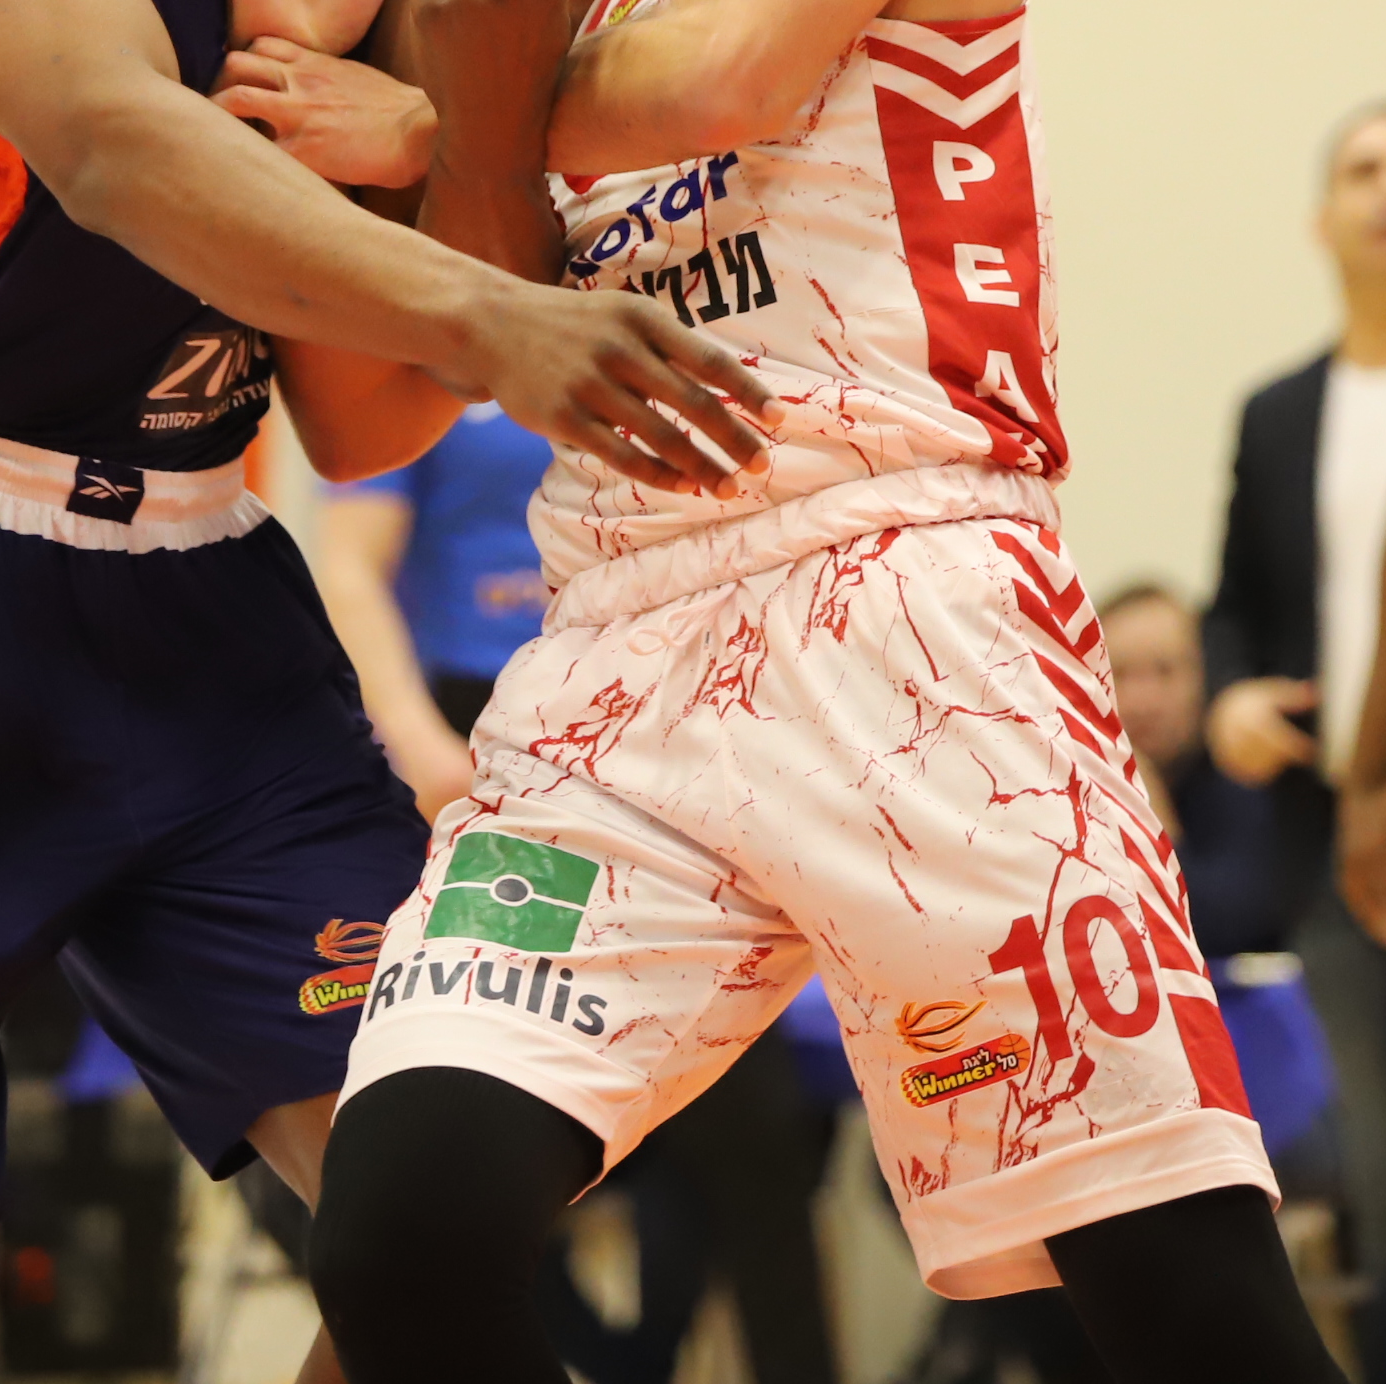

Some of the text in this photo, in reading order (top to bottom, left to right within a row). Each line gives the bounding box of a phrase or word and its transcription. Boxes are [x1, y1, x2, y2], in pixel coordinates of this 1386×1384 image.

[365, 950, 610, 1038] Rivulis
[987, 894, 1161, 1063] 10
[961, 1048, 990, 1069] ליגת
[995, 1054, 1017, 1071] סל
[913, 1062, 996, 1098] Winner
